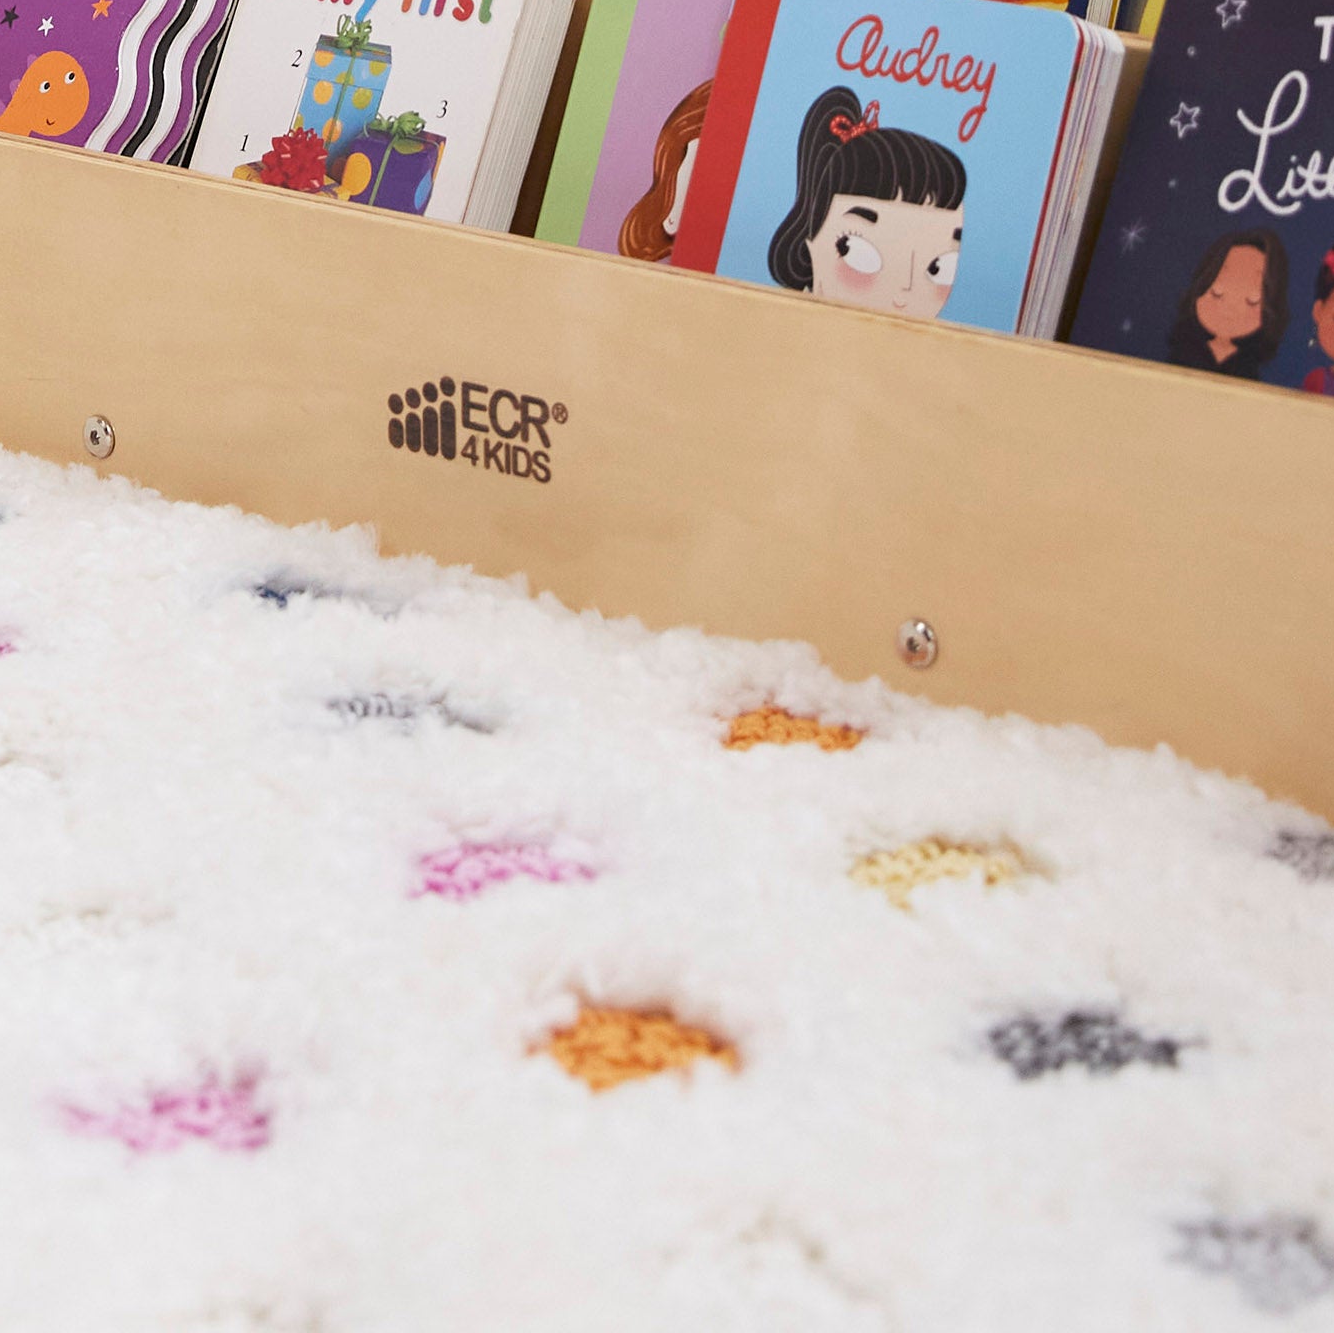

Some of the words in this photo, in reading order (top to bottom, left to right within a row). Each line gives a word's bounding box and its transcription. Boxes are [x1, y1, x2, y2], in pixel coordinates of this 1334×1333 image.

[291, 49, 303, 68] 2
[836, 13, 996, 142] Audrey
[436, 99, 448, 118] 3
[240, 134, 249, 152] 1
